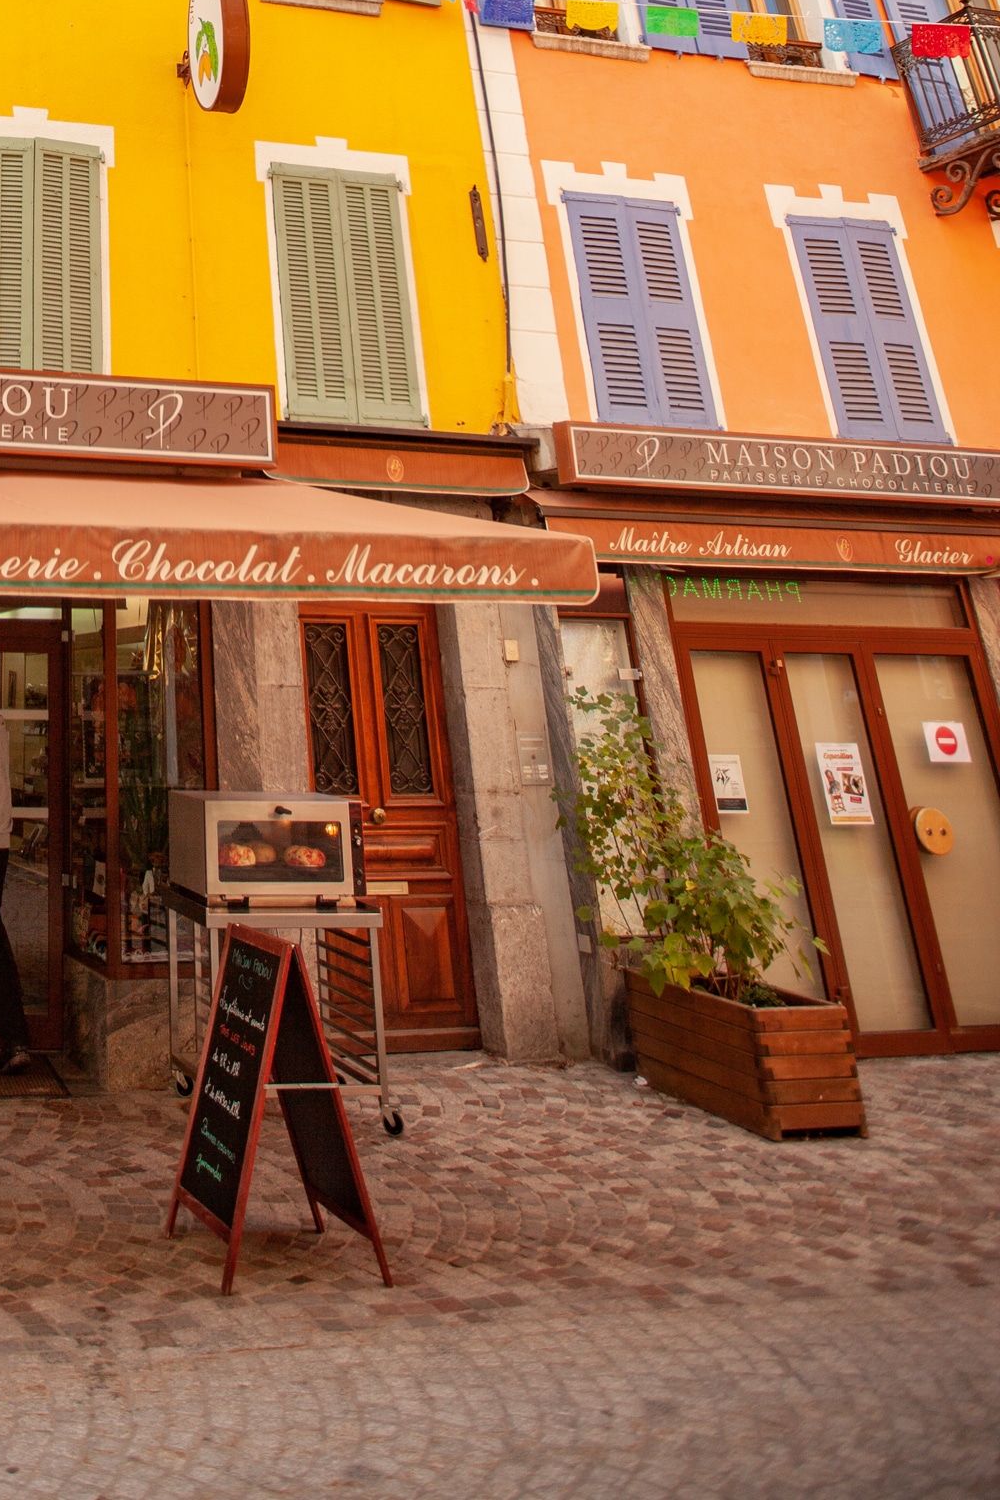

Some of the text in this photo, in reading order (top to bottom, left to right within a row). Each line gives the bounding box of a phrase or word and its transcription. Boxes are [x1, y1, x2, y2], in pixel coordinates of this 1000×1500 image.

[706, 442, 971, 480] MAISON PADIOU
[710, 469, 976, 495] PATISSERIE-CHOCOLATERIE
[112, 539, 304, 584] Chocolat
[327, 543, 527, 587] Macarons
[609, 527, 975, 566] Maître Artisan Glacier
[823, 752, 853, 761] Exposition
